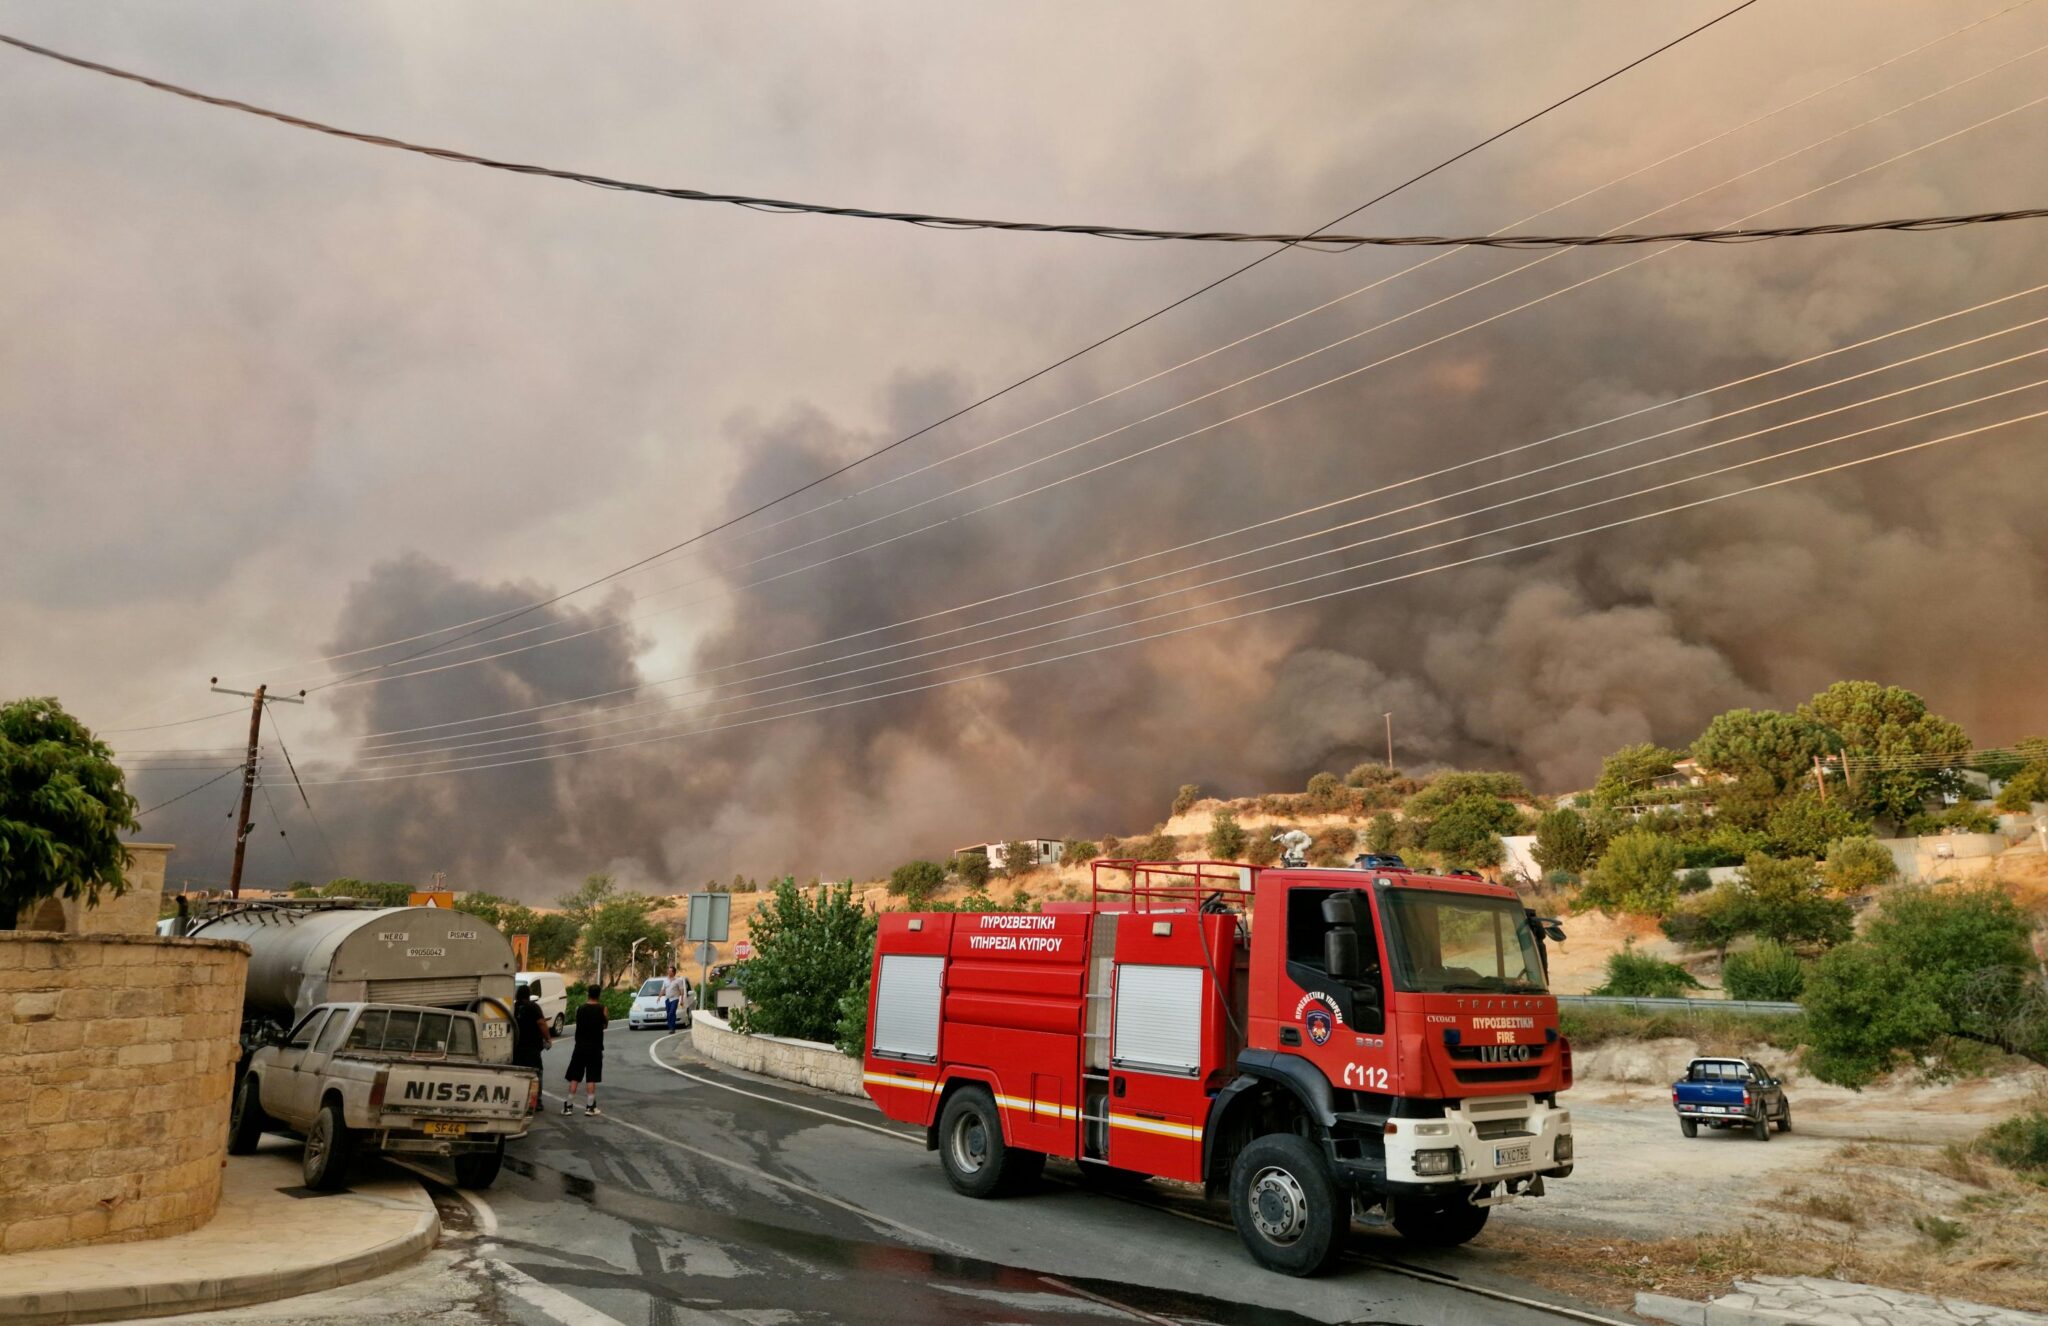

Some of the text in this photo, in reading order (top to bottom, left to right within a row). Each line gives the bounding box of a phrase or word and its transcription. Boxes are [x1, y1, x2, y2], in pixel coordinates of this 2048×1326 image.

[980, 915, 1056, 930] ΠΥΡΟΣΒΕΣΤΙΚΗ
[450, 931, 474, 939] PISINES
[736, 945, 750, 955] STOP
[970, 936, 1062, 952] ΥΠΗΡΕΣΙΑ ΚΥΠΡΟΥ
[1295, 991, 1344, 1024] ΠΥΡΟΣΒΕΣΤΙΚΗ ΥΠΗΡΕΣΙΑ
[1472, 1017, 1534, 1029] ΠΥΡΟΣΒΕΣΤΙΚΗ
[1355, 1037, 1384, 1048] 330
[1496, 1031, 1516, 1044] FIRE
[1481, 1045, 1530, 1063] IVECO
[1355, 1065, 1388, 1089] 112
[404, 1081, 511, 1104] NISSAN
